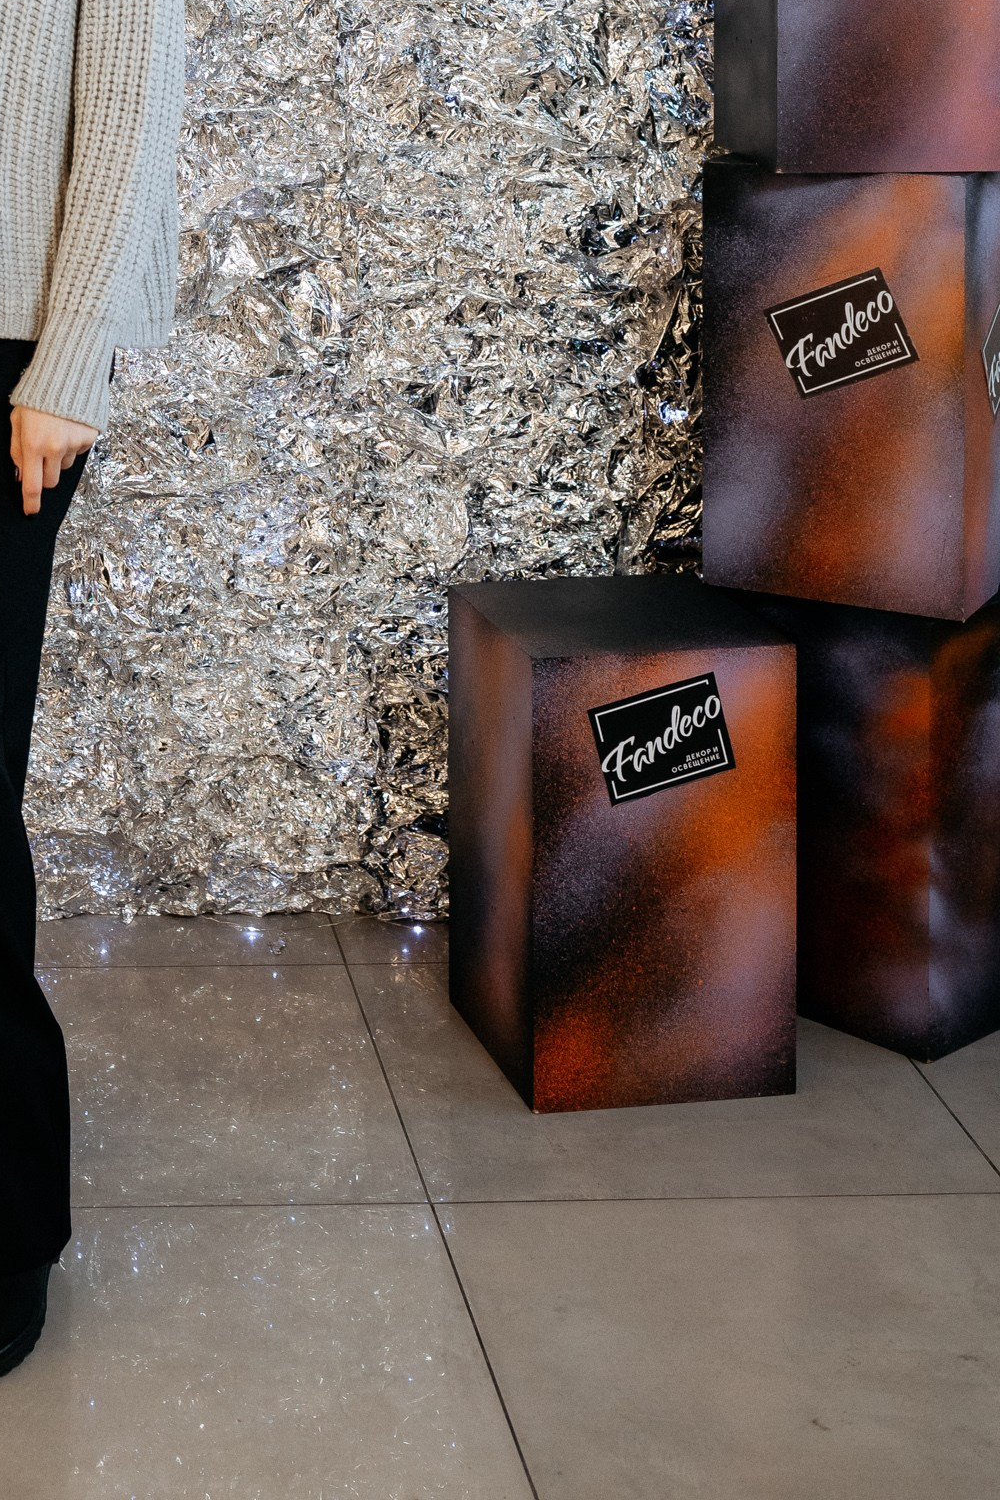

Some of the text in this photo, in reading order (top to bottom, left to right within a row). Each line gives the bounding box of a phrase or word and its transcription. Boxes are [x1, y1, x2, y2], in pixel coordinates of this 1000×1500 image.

[785, 290, 894, 377] Fandeco
[854, 346, 902, 368] ОСВЕЩЕНИЕ
[866, 341, 892, 357] ДЕКОР
[601, 694, 721, 782] Fandeco
[671, 753, 720, 773] ОСВЕЩЕНИЕ
[685, 748, 712, 762] ДЕКОР
